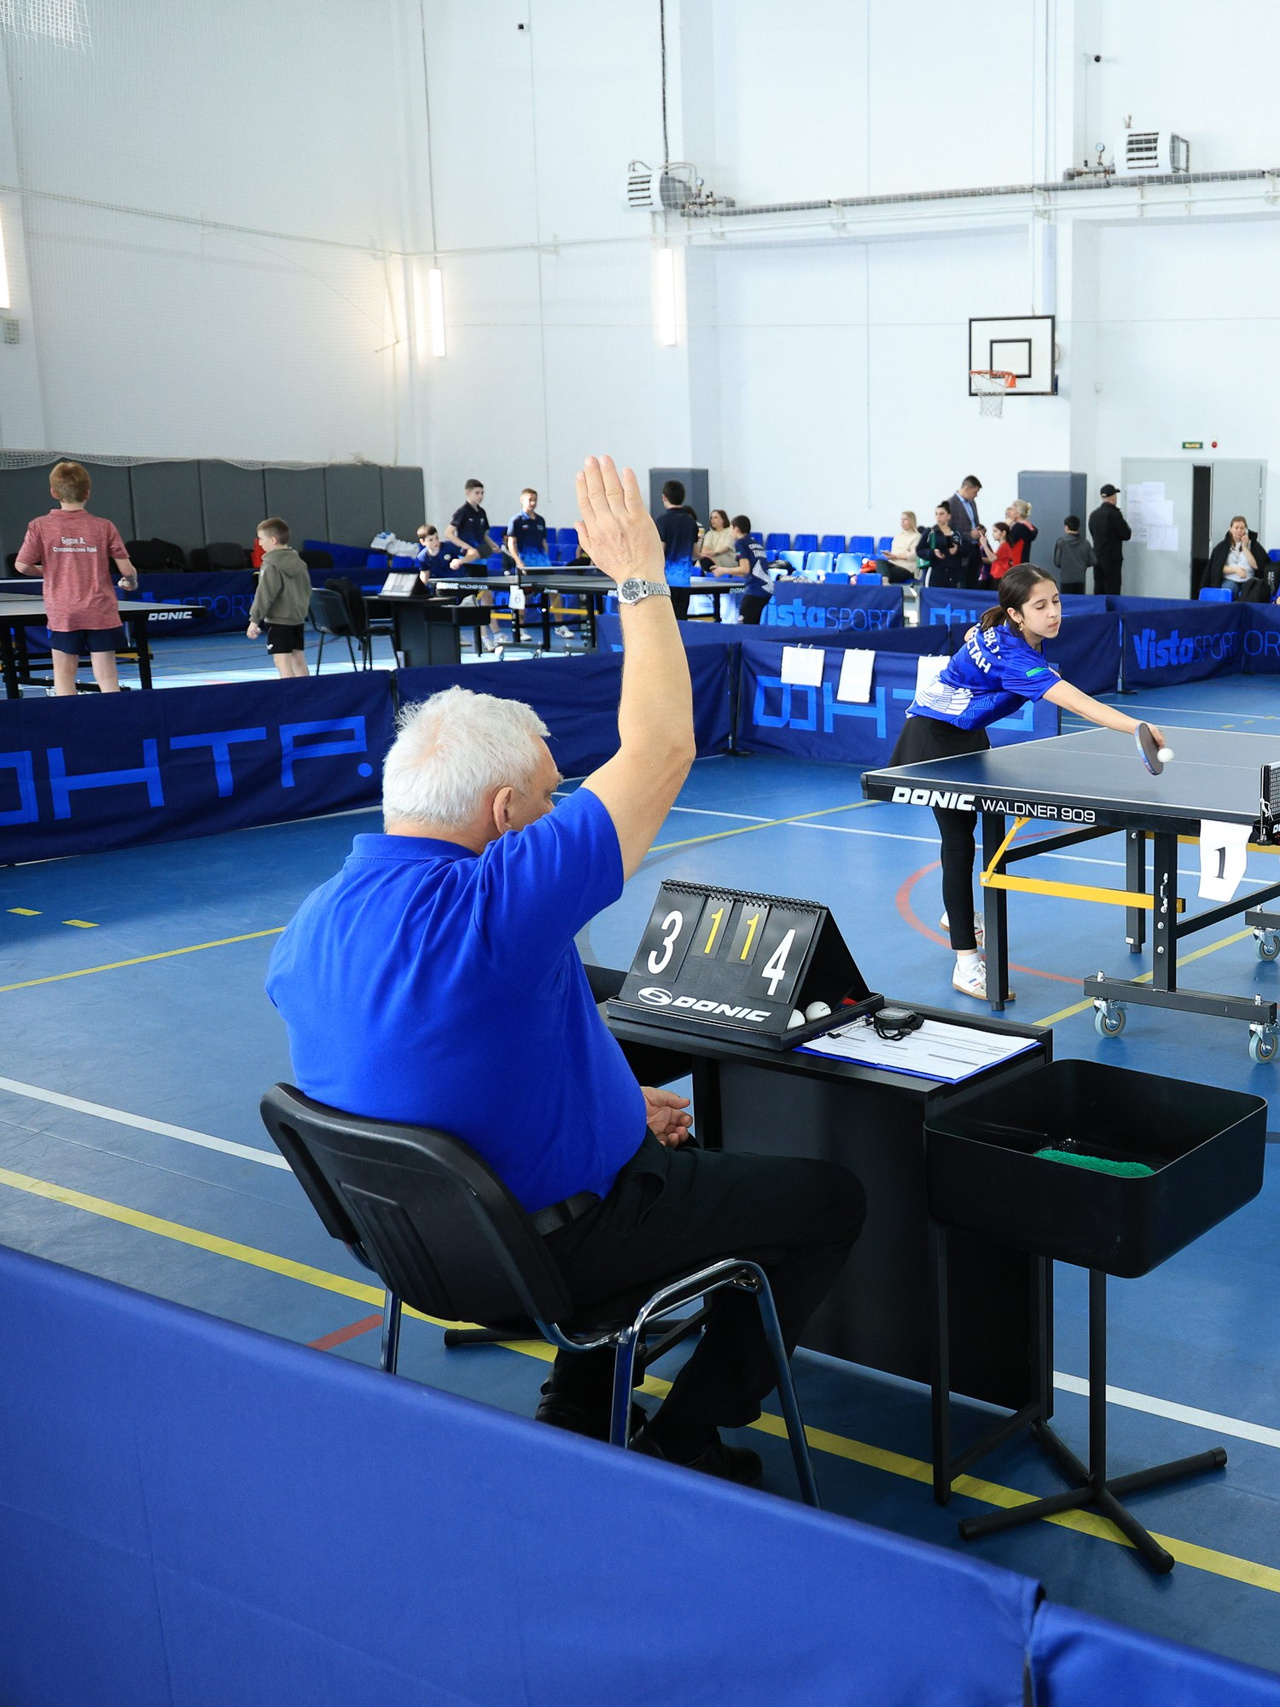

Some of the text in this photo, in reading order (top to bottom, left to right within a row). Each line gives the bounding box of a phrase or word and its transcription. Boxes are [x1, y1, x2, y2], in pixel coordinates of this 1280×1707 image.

[147, 611, 193, 621] DONIC
[891, 786, 1096, 823] DONIC WALDNER 909
[1214, 846, 1226, 879] 1
[647, 908, 796, 996] 3 1 1 4
[671, 996, 771, 1023] DONIC
